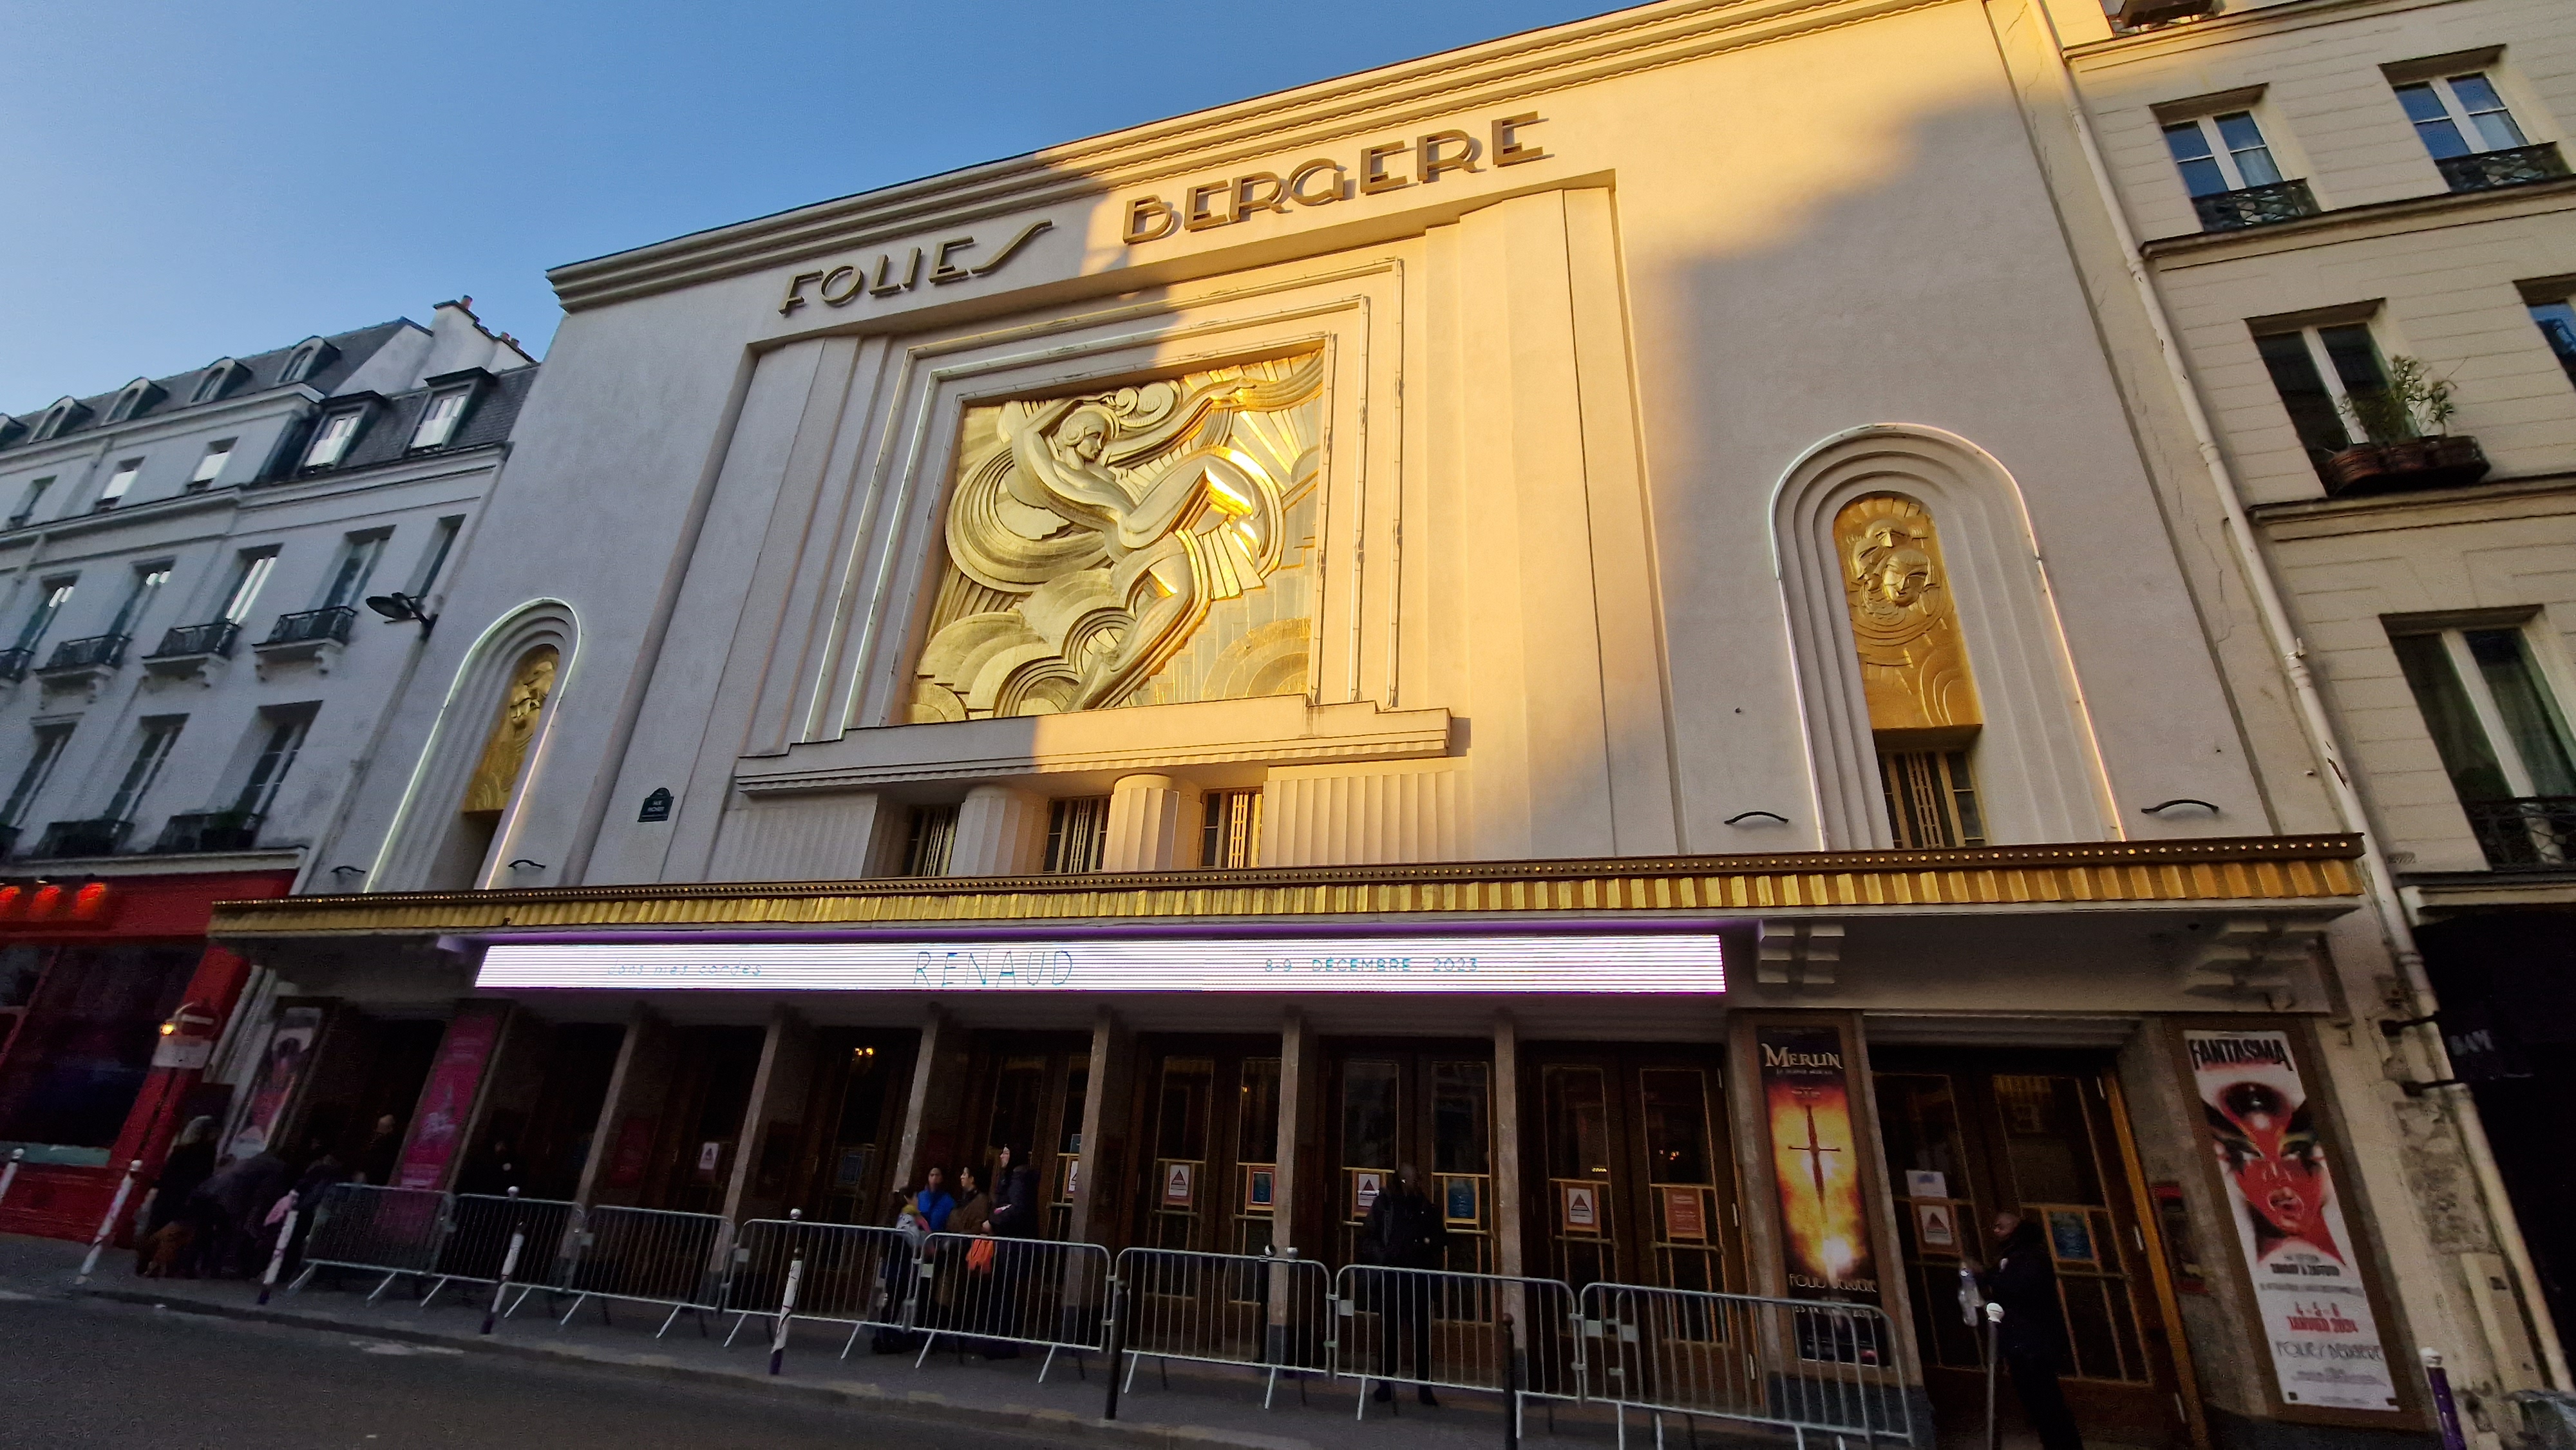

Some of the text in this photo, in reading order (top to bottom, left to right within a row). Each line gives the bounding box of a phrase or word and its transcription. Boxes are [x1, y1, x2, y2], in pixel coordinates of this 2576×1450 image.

[778, 111, 1544, 315] FOLIES BERGERE
[653, 965, 688, 975] mes
[699, 957, 762, 976] cordes
[913, 948, 1073, 988] RENAUD
[1312, 956, 1412, 972] DÉCEMBRE
[1432, 957, 1478, 972] 2023
[2188, 1039, 2294, 1071] FANTASMA
